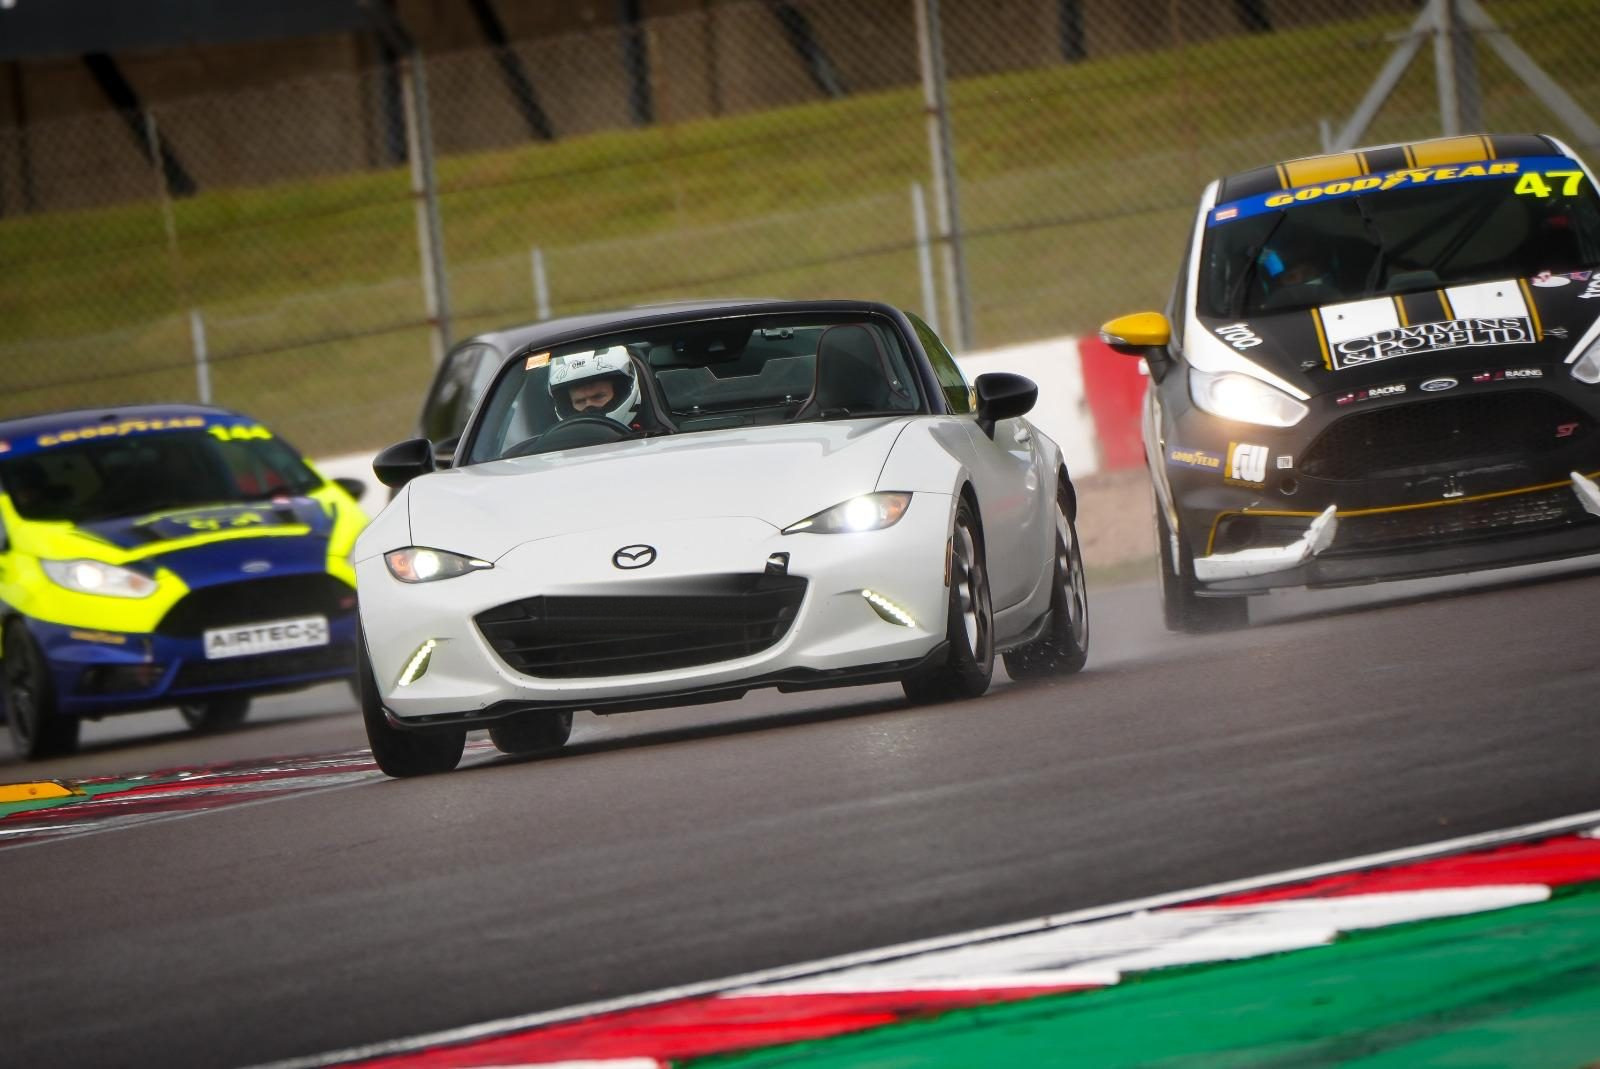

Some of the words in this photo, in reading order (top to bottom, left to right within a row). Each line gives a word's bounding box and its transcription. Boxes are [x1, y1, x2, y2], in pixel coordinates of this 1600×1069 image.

[1265, 162, 1519, 207] GOODYEAR
[1514, 171, 1584, 198] 47
[1337, 317, 1521, 353] CUMMINS
[1342, 352, 1369, 365] &
[1372, 332, 1467, 360] POPE
[1505, 369, 1543, 378] RACING
[1368, 384, 1407, 396] RACING
[37, 416, 205, 447] GOODYEAR
[212, 623, 300, 648] AIRTEC
